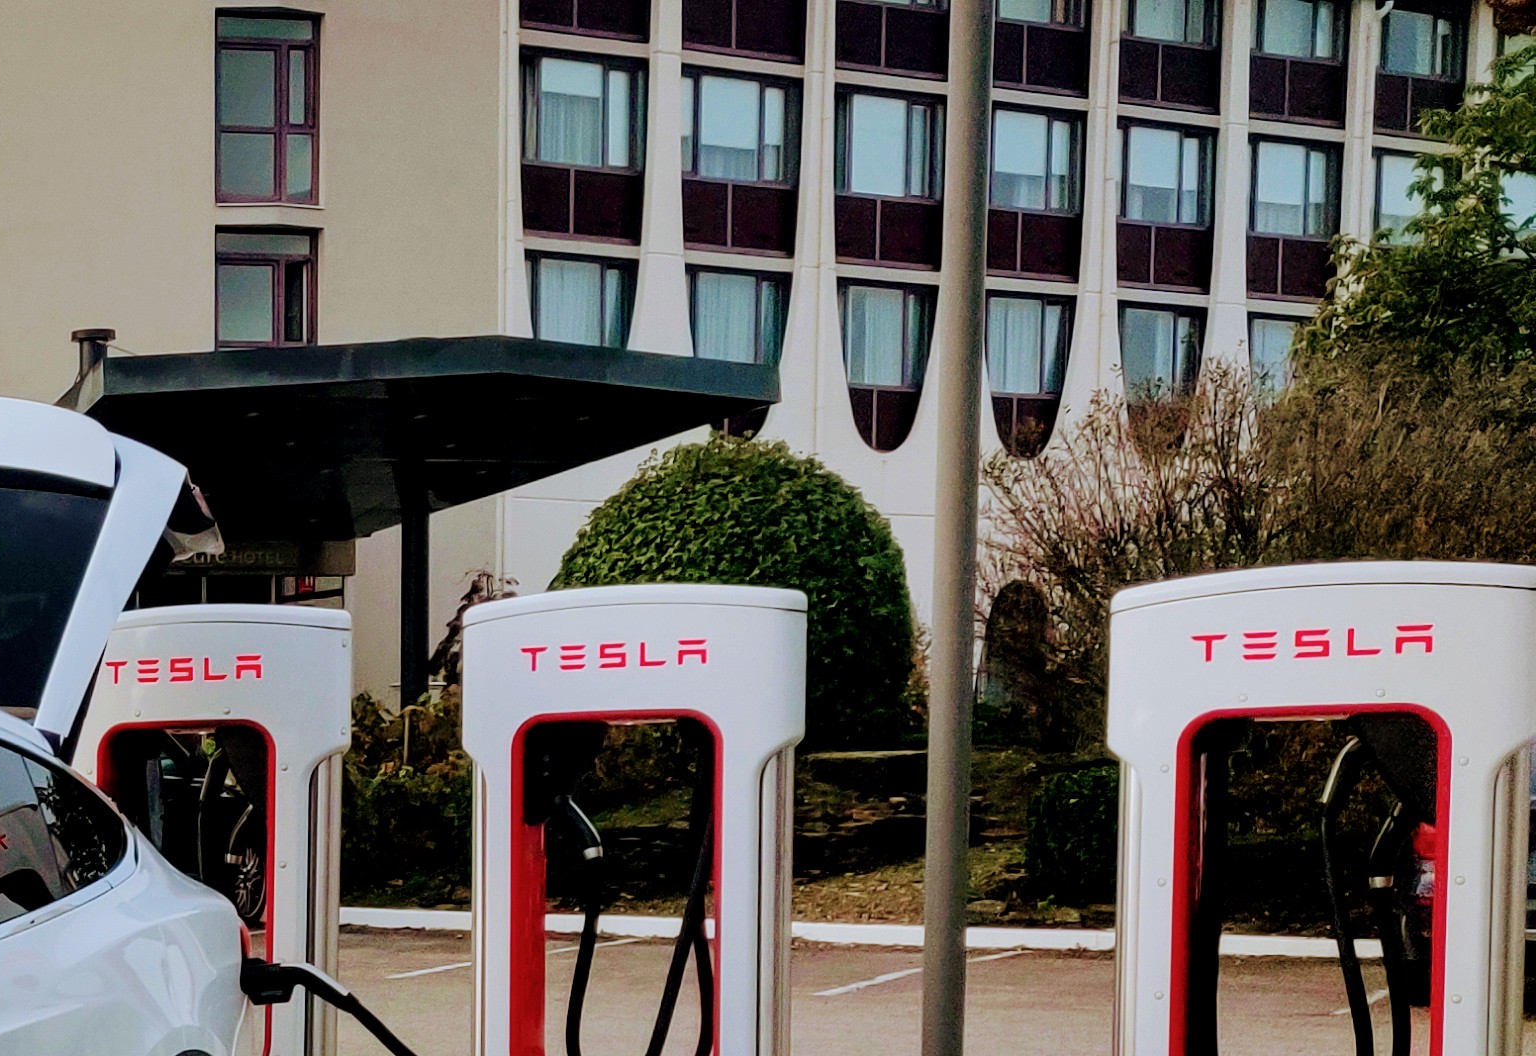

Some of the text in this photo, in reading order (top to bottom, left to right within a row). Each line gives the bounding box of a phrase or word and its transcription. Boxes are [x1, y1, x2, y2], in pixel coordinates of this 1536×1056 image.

[521, 639, 707, 671] TESLA
[1192, 624, 1434, 662] TESLA
[106, 654, 262, 684] TESLA
